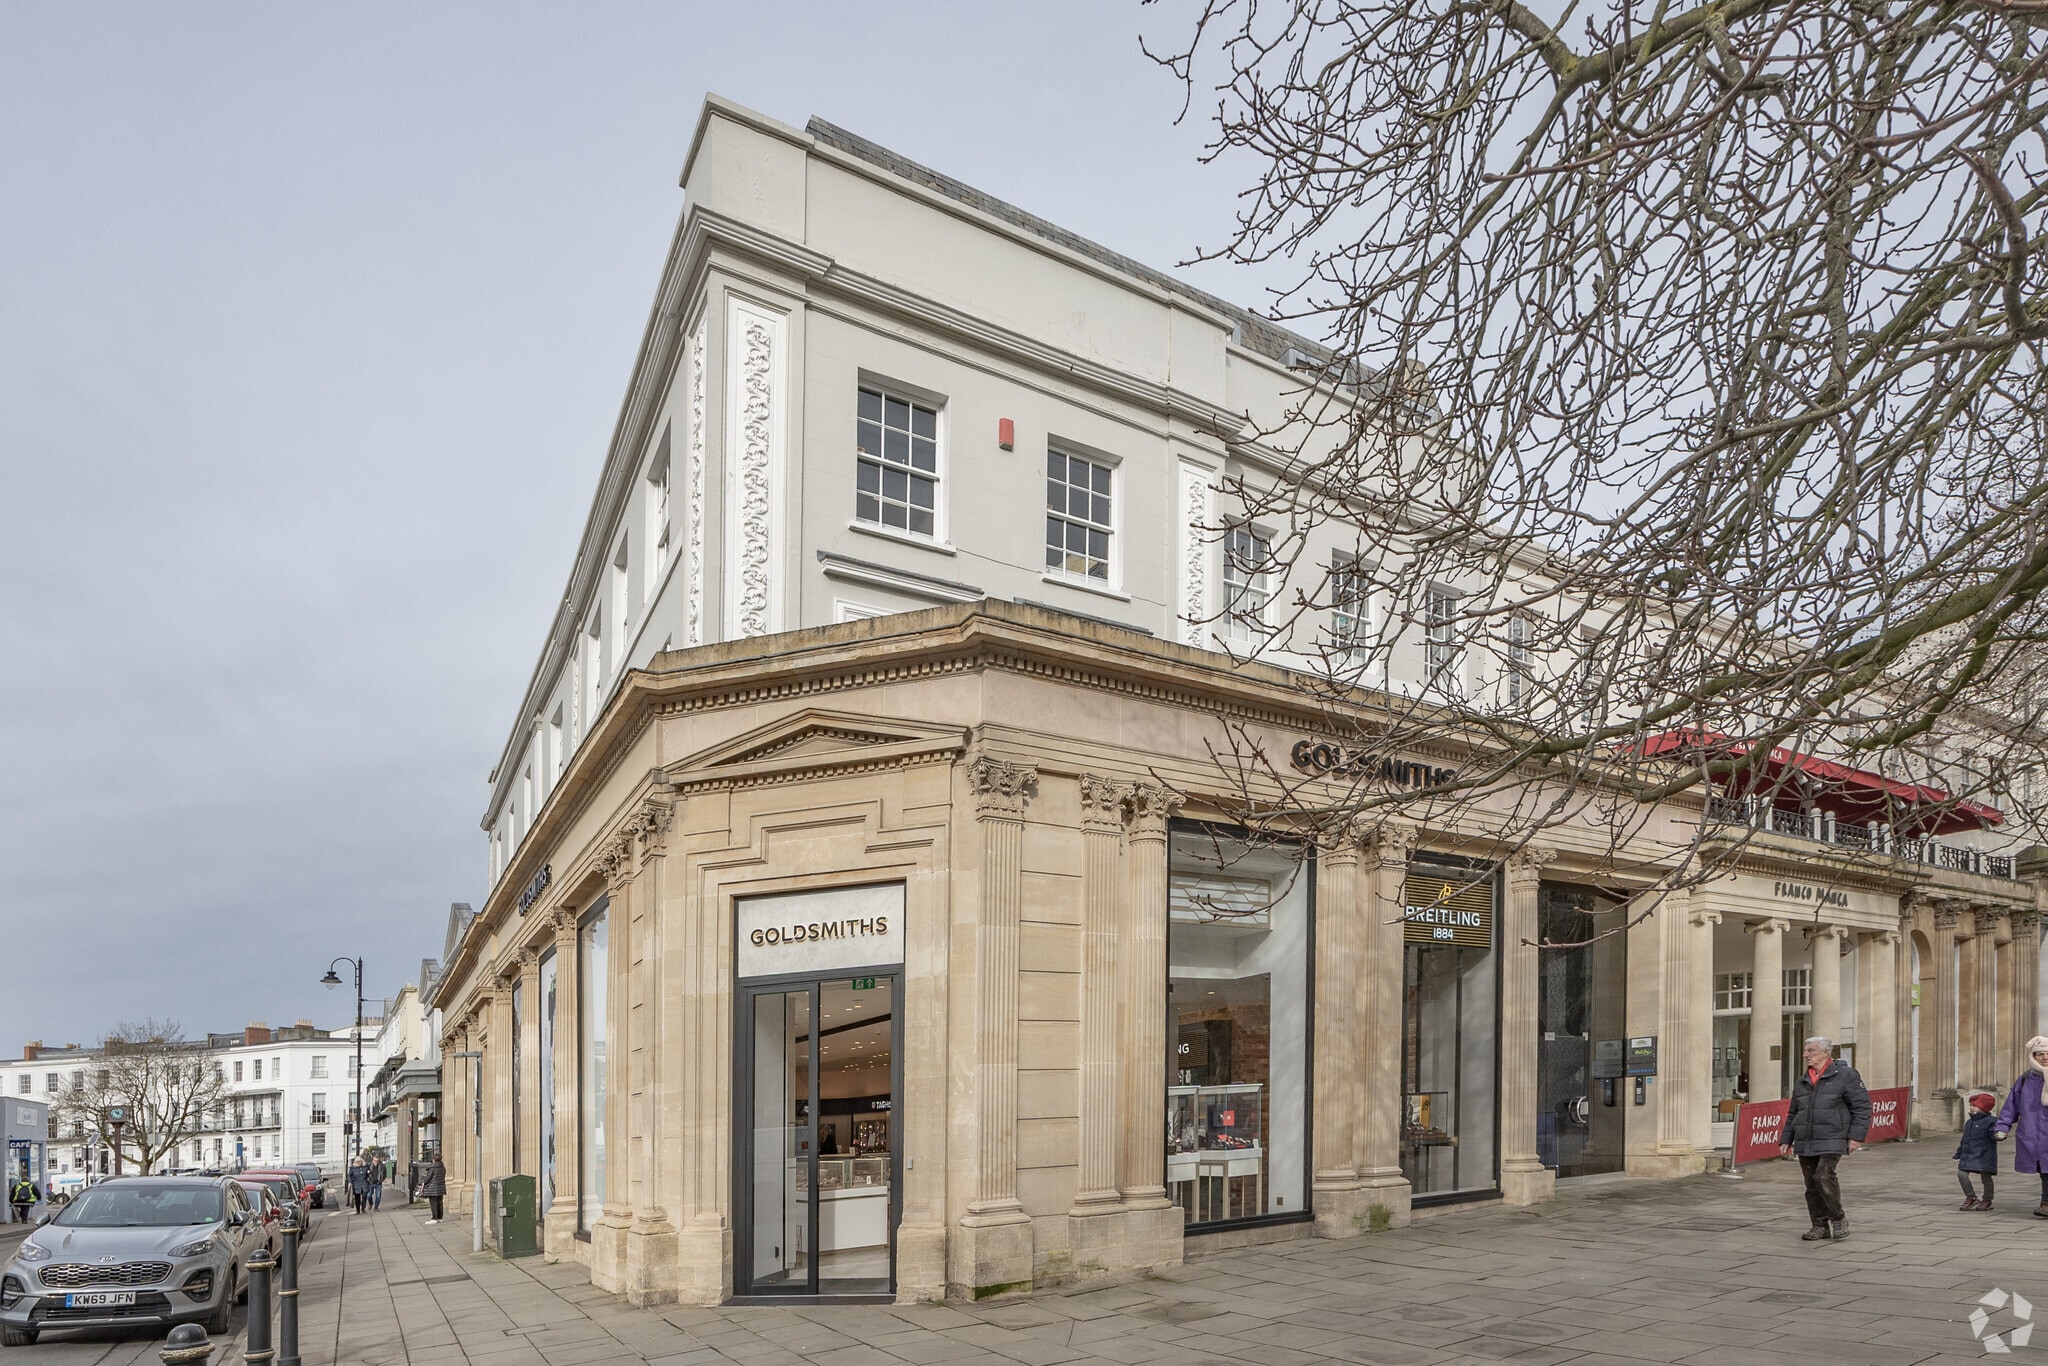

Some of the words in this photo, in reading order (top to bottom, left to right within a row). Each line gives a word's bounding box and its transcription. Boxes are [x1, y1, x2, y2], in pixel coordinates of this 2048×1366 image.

[1774, 881, 1812, 900] FRANCO
[1815, 887, 1848, 907] MANCA
[1405, 906, 1480, 927] BREITLING
[750, 916, 888, 946] GOLDSMITHS
[1433, 927, 1454, 940] 1884
[1872, 1100, 1897, 1113] FRANCO
[1752, 1115, 1781, 1130] FRANCO
[1871, 1114, 1894, 1128] MANCA
[1750, 1130, 1779, 1147] MANCA
[74, 1294, 107, 1305] KW69
[109, 1293, 133, 1303] JFN
